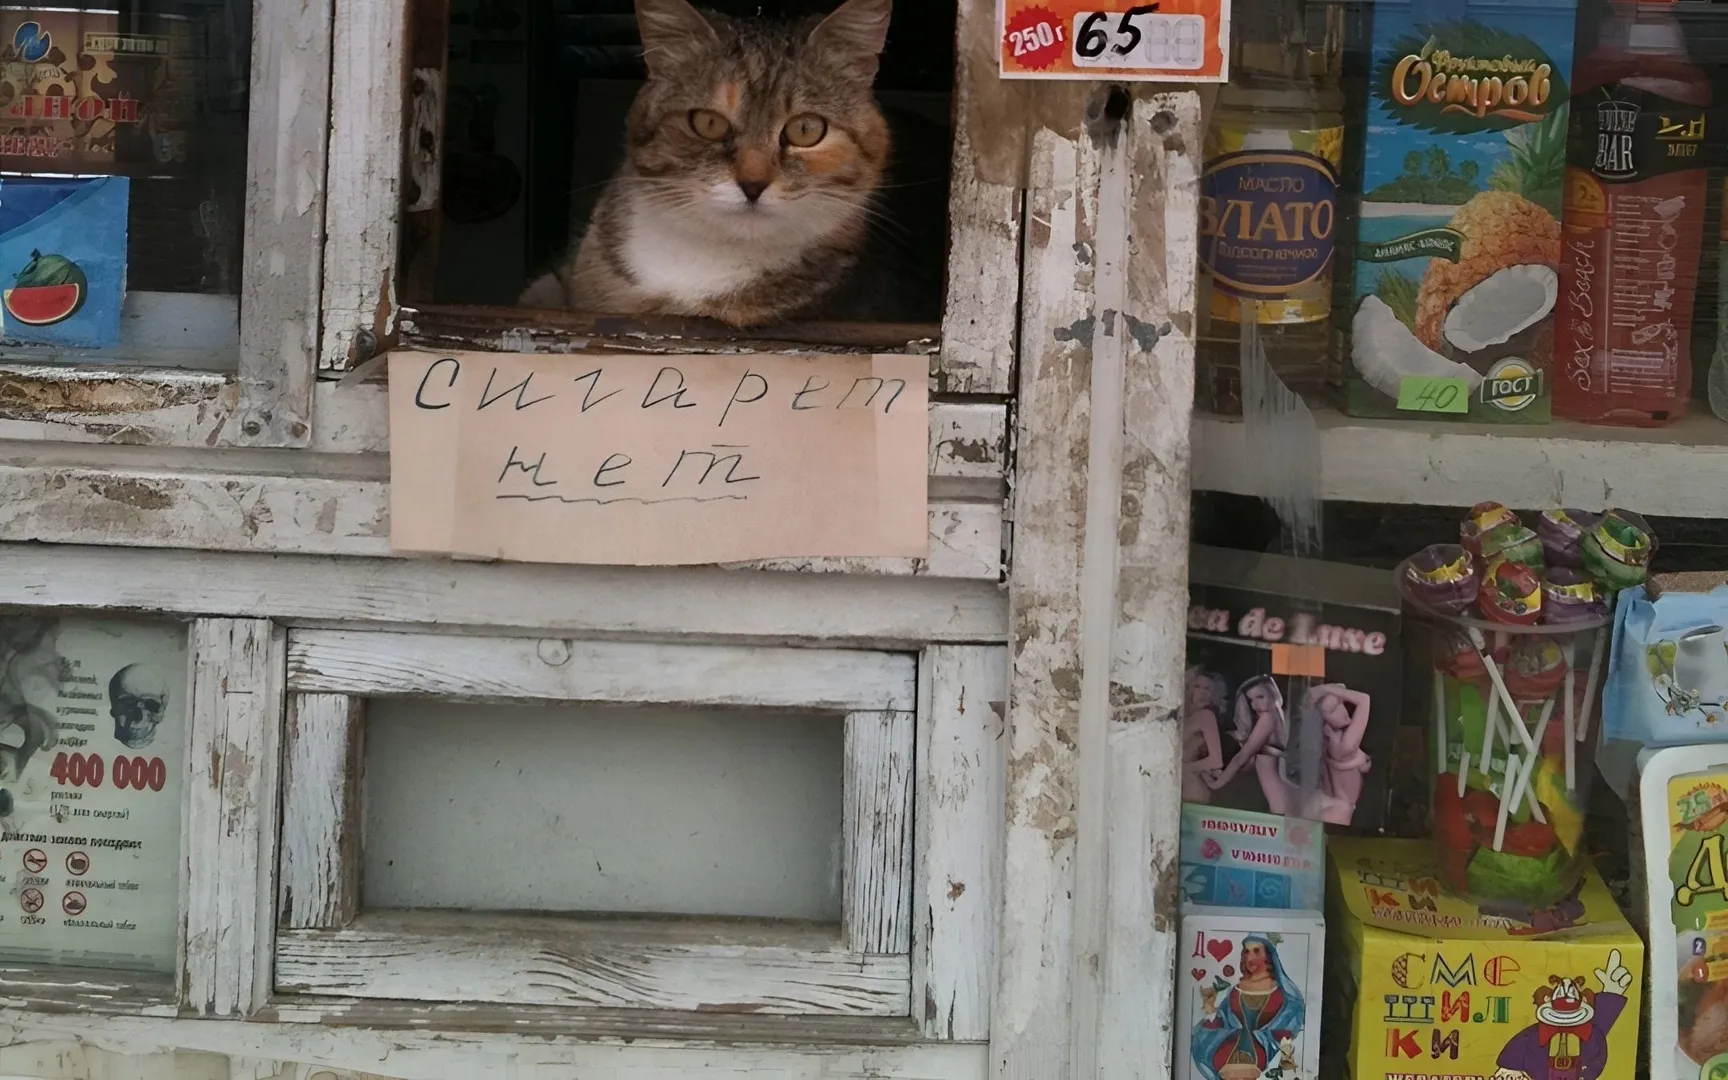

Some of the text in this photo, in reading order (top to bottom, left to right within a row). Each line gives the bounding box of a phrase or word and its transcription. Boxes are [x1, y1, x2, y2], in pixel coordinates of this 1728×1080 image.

[1075, 1, 1160, 58] 65
[1392, 52, 1552, 119] Остров
[414, 357, 906, 428] Сигарет
[1415, 381, 1459, 410] 40
[497, 442, 761, 488] нет
[50, 751, 167, 793] 400 000
[1383, 990, 1513, 1024] ШИЛ
[1384, 1027, 1461, 1061] КИ
